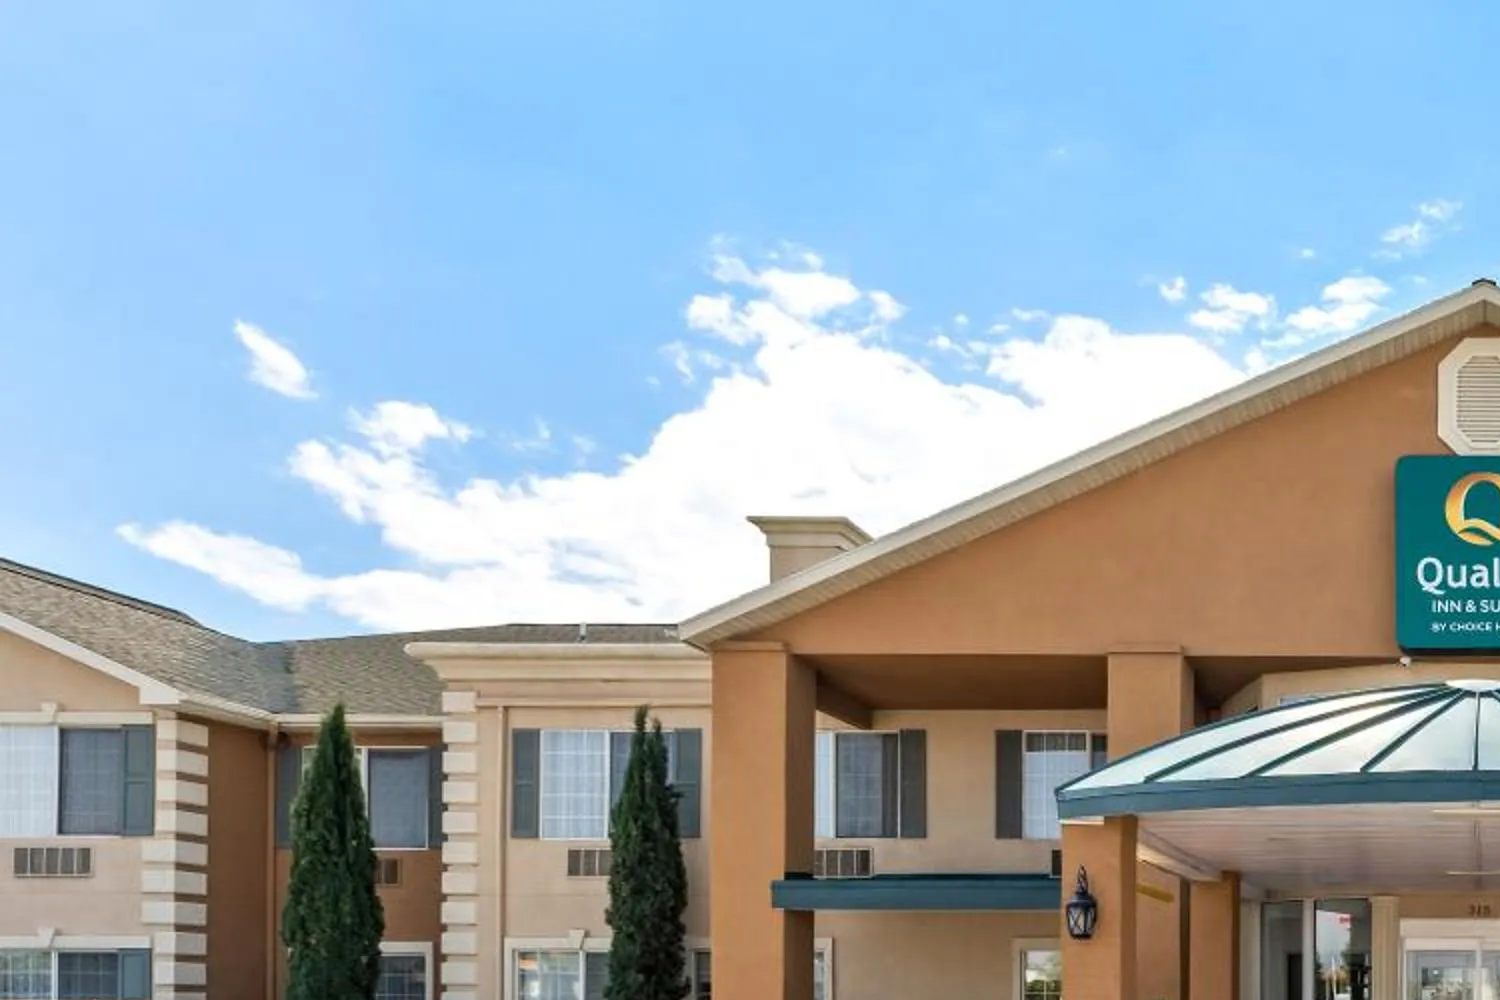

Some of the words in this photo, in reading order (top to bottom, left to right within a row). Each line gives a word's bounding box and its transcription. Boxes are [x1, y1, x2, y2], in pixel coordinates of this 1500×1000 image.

[1432, 600, 1462, 613] INN
[1465, 600, 1477, 613] &
[1431, 622, 1446, 632] BY
[1449, 622, 1492, 632] CHOICE
